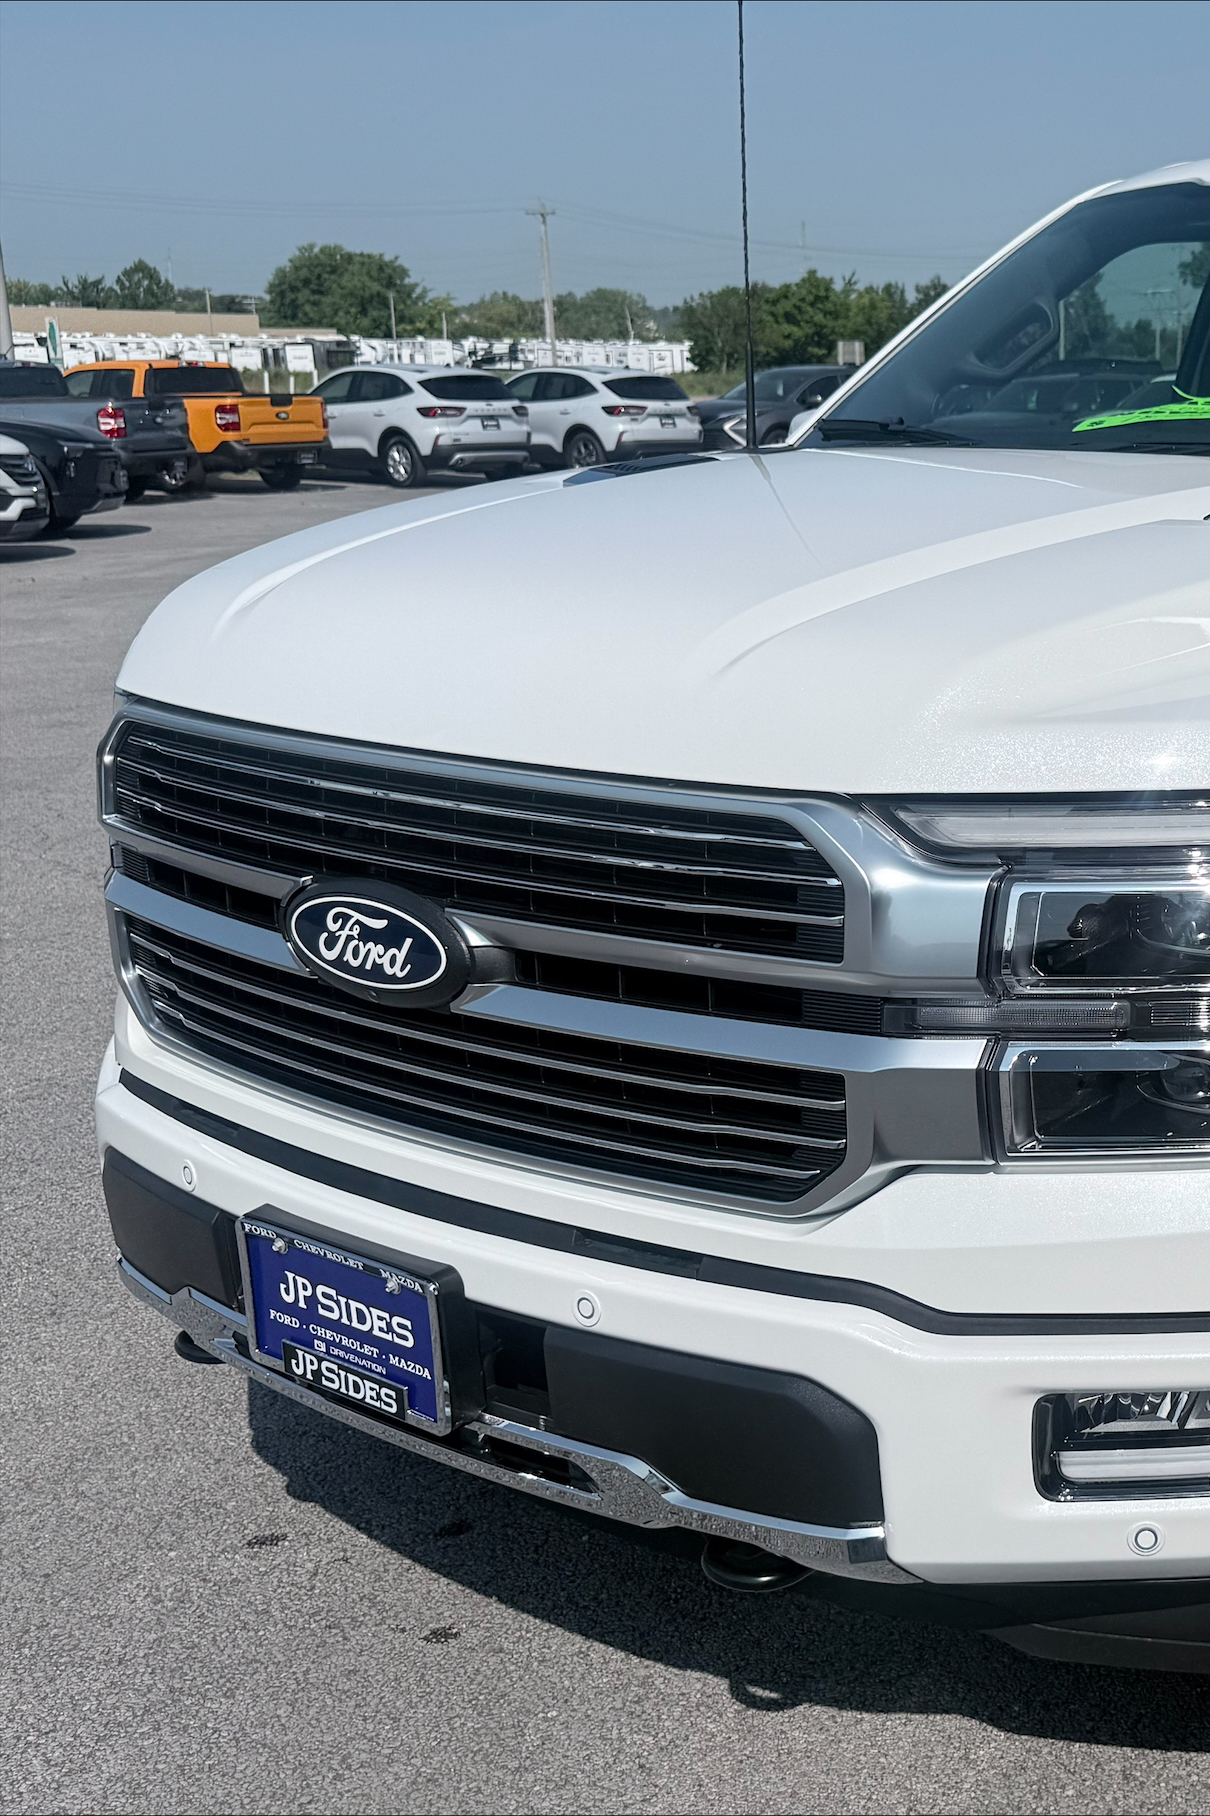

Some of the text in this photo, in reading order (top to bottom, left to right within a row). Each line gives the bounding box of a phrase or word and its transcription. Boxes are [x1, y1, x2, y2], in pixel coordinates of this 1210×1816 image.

[318, 906, 414, 978] Ford
[243, 1222, 424, 1293] FORD CHEVROLET MAZDA
[268, 1308, 432, 1380] FORD CHEVROLET MAZDA
[279, 1270, 415, 1348] JP SIDES
[290, 1348, 398, 1414] JP SIDES
[329, 1345, 387, 1375] DRIVENATION
